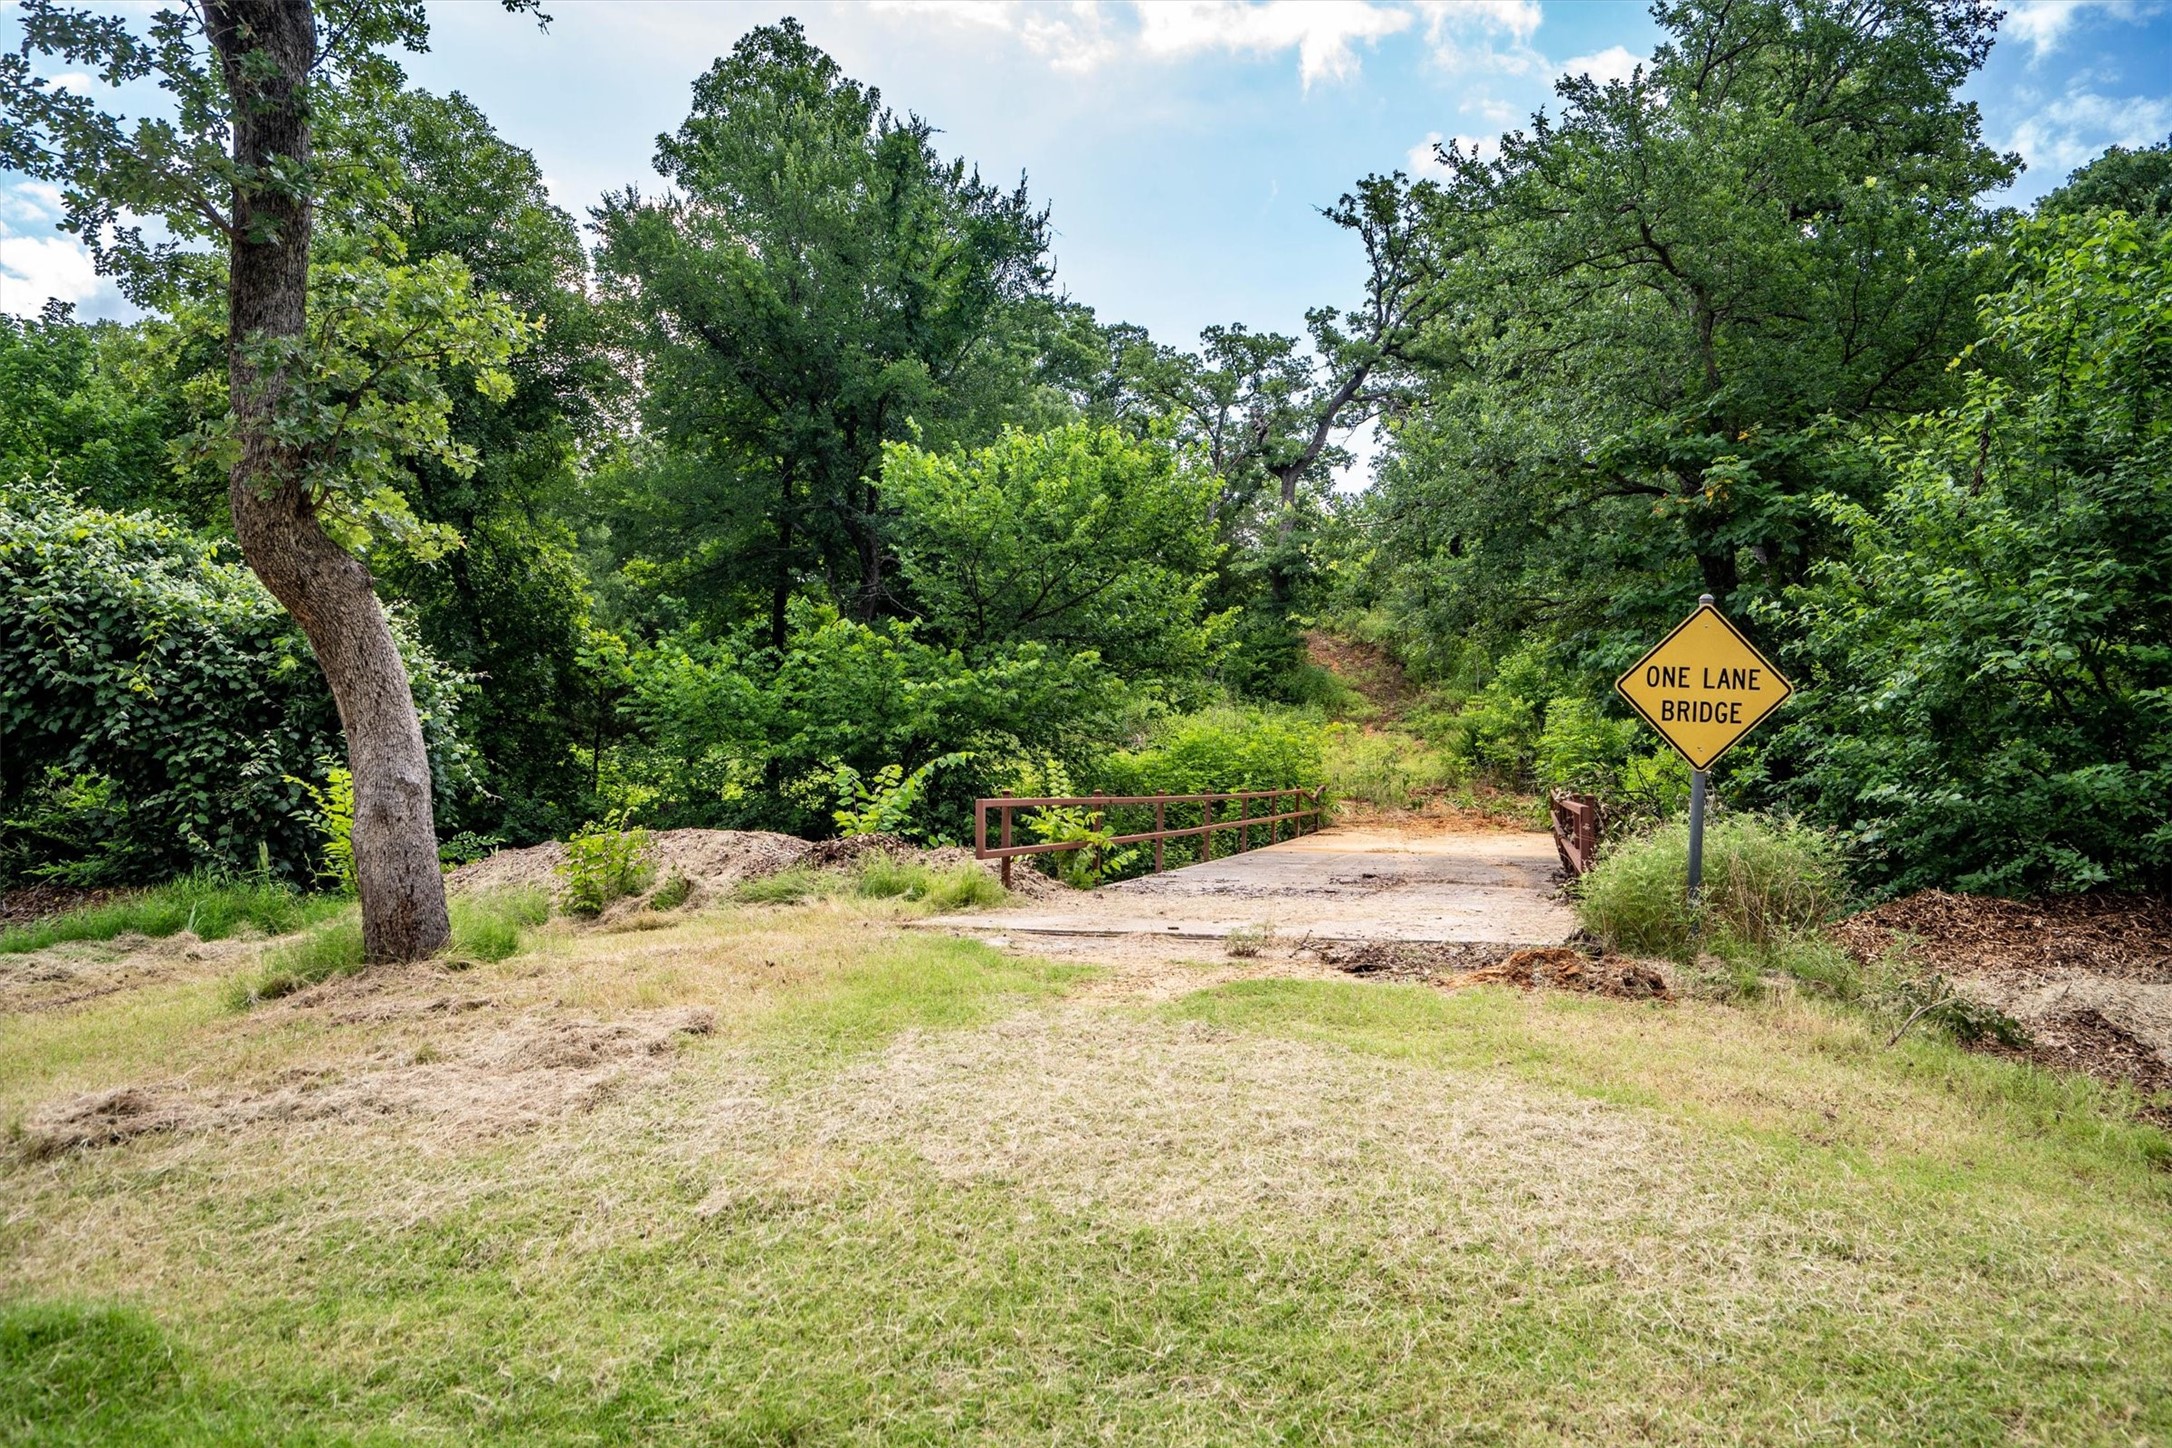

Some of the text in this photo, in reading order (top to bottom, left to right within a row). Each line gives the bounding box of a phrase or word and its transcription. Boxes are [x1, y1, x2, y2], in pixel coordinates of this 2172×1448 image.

[1646, 665, 1761, 690] ONE LANE
[1661, 700, 1742, 724] BRIDGE
